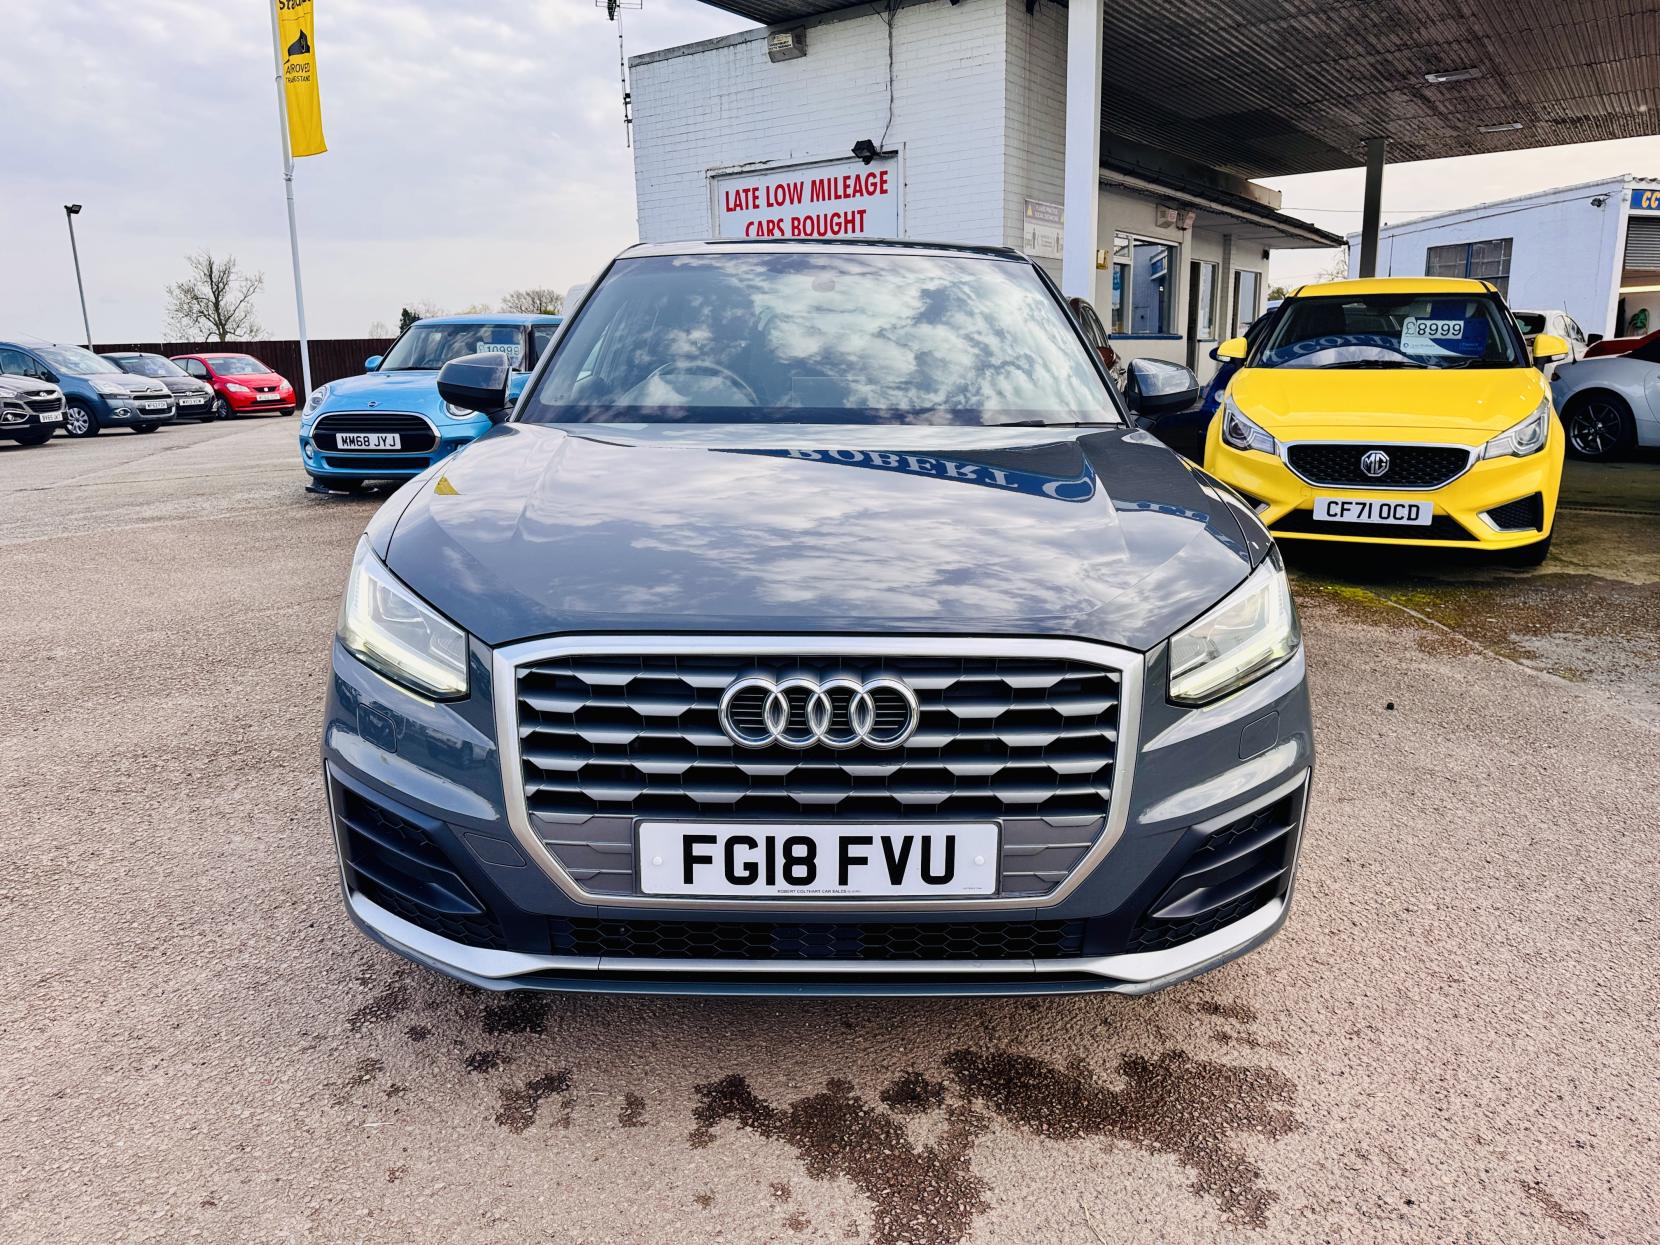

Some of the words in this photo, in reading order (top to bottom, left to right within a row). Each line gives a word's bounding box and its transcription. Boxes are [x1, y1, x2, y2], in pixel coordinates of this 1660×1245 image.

[725, 187, 760, 213] LATE
[766, 181, 804, 208] LOW
[810, 170, 889, 203] MILEAGE
[745, 218, 785, 237] CARS
[791, 209, 867, 238] BOUGHT
[341, 435, 370, 447] MM68
[374, 435, 396, 447] JYJ
[1363, 452, 1388, 475] MG
[1326, 501, 1373, 519] CF71
[1379, 503, 1420, 521] OCD
[682, 834, 817, 886] FG18
[838, 835, 956, 886] FVU
